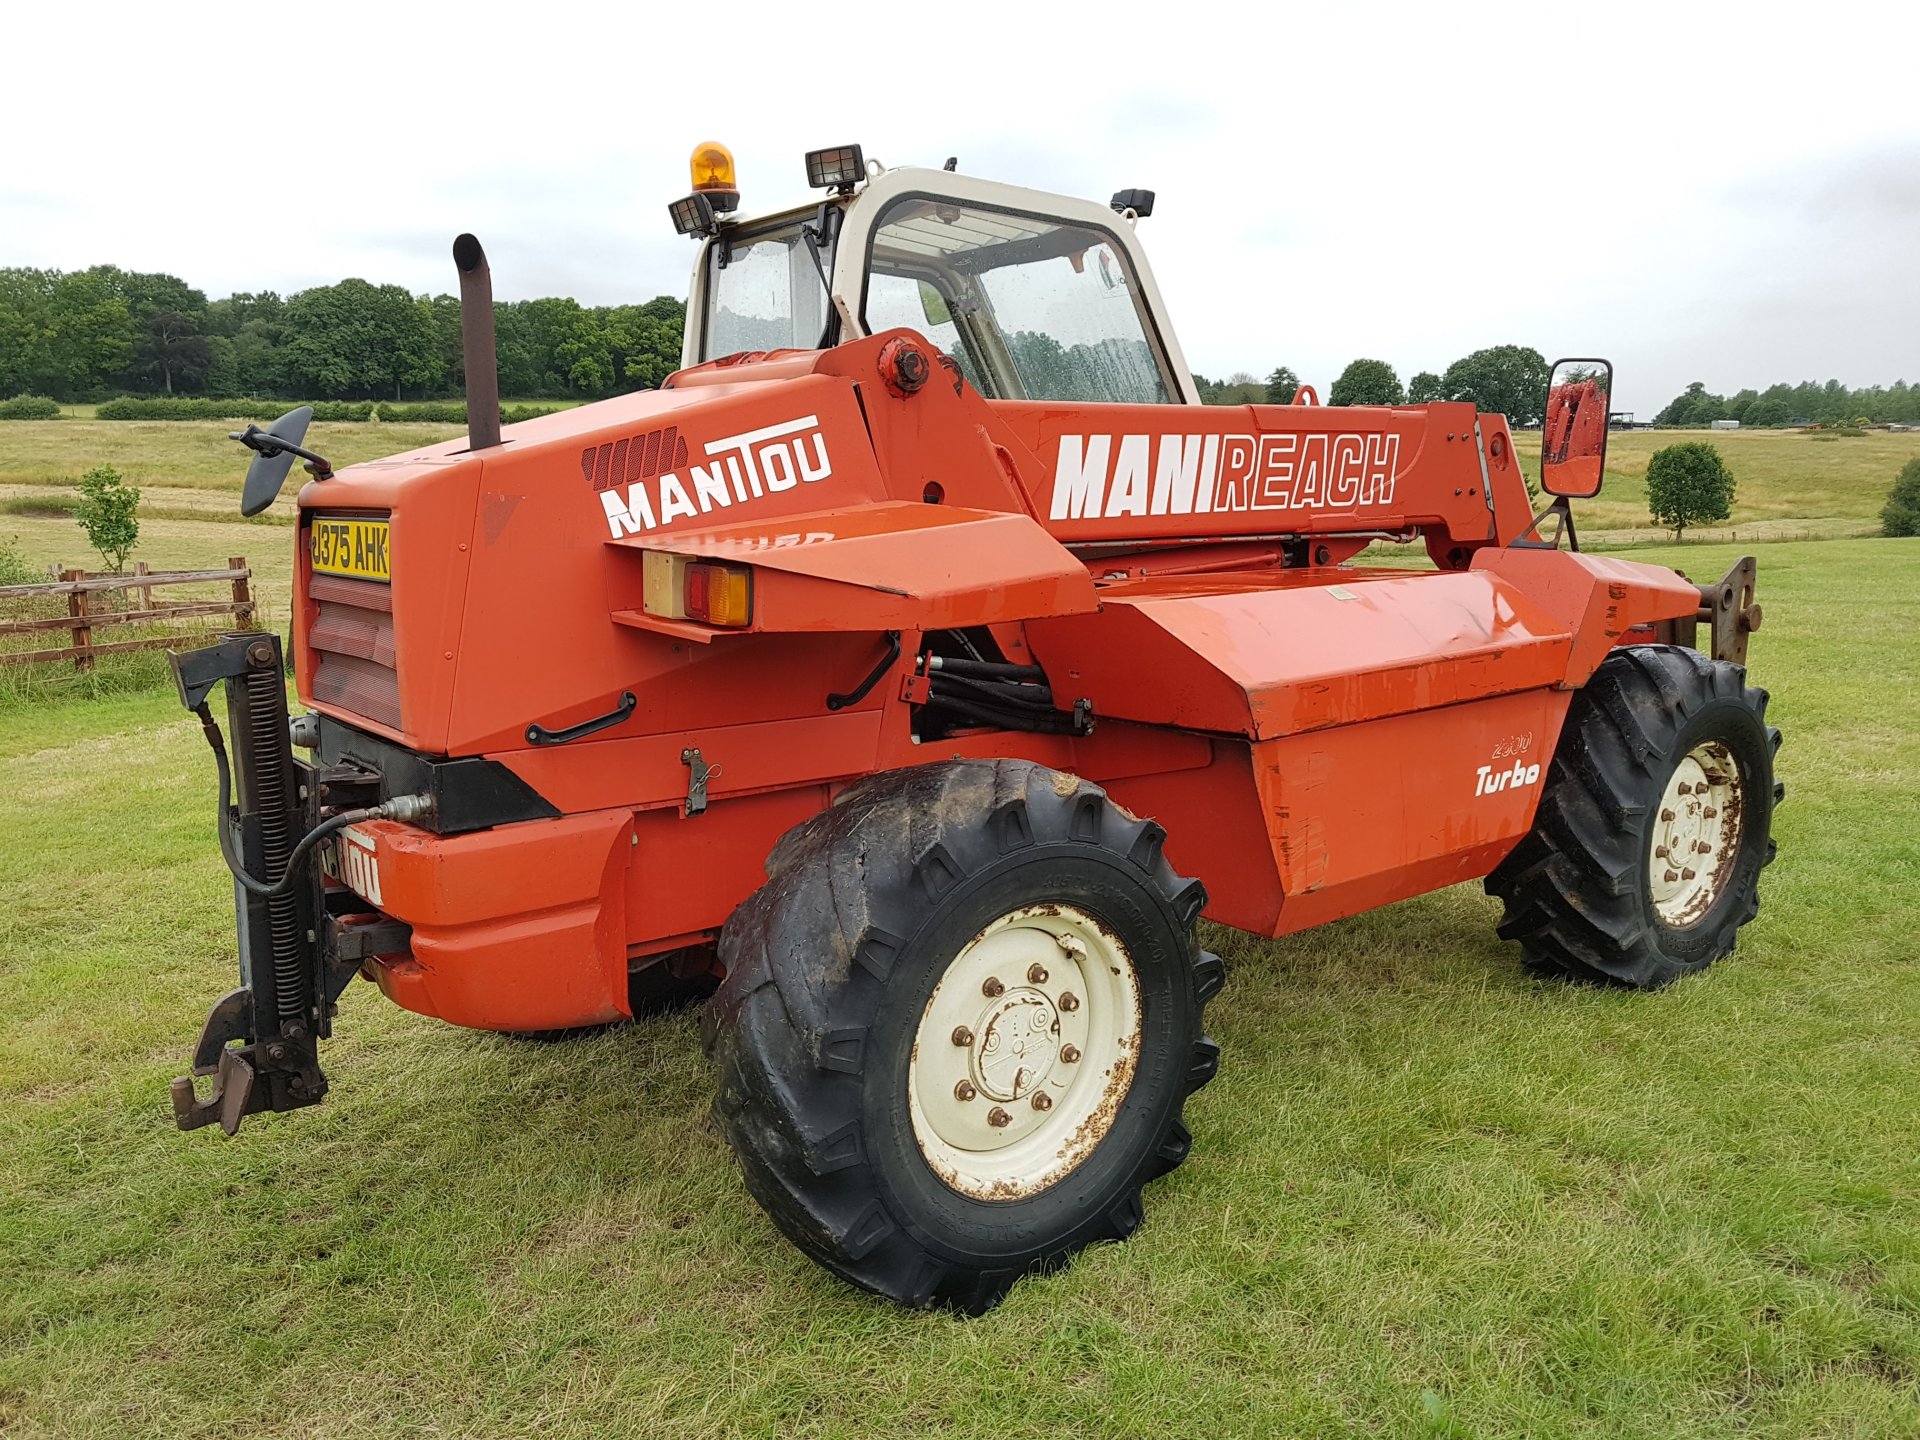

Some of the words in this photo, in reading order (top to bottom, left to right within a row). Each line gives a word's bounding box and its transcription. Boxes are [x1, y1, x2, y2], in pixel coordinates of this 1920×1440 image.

[599, 414, 832, 540] MANITOU
[1049, 433, 1400, 520] MANIREACH
[313, 523, 351, 569] J375
[354, 525, 388, 574] AHK
[1475, 758, 1540, 797] Turbo
